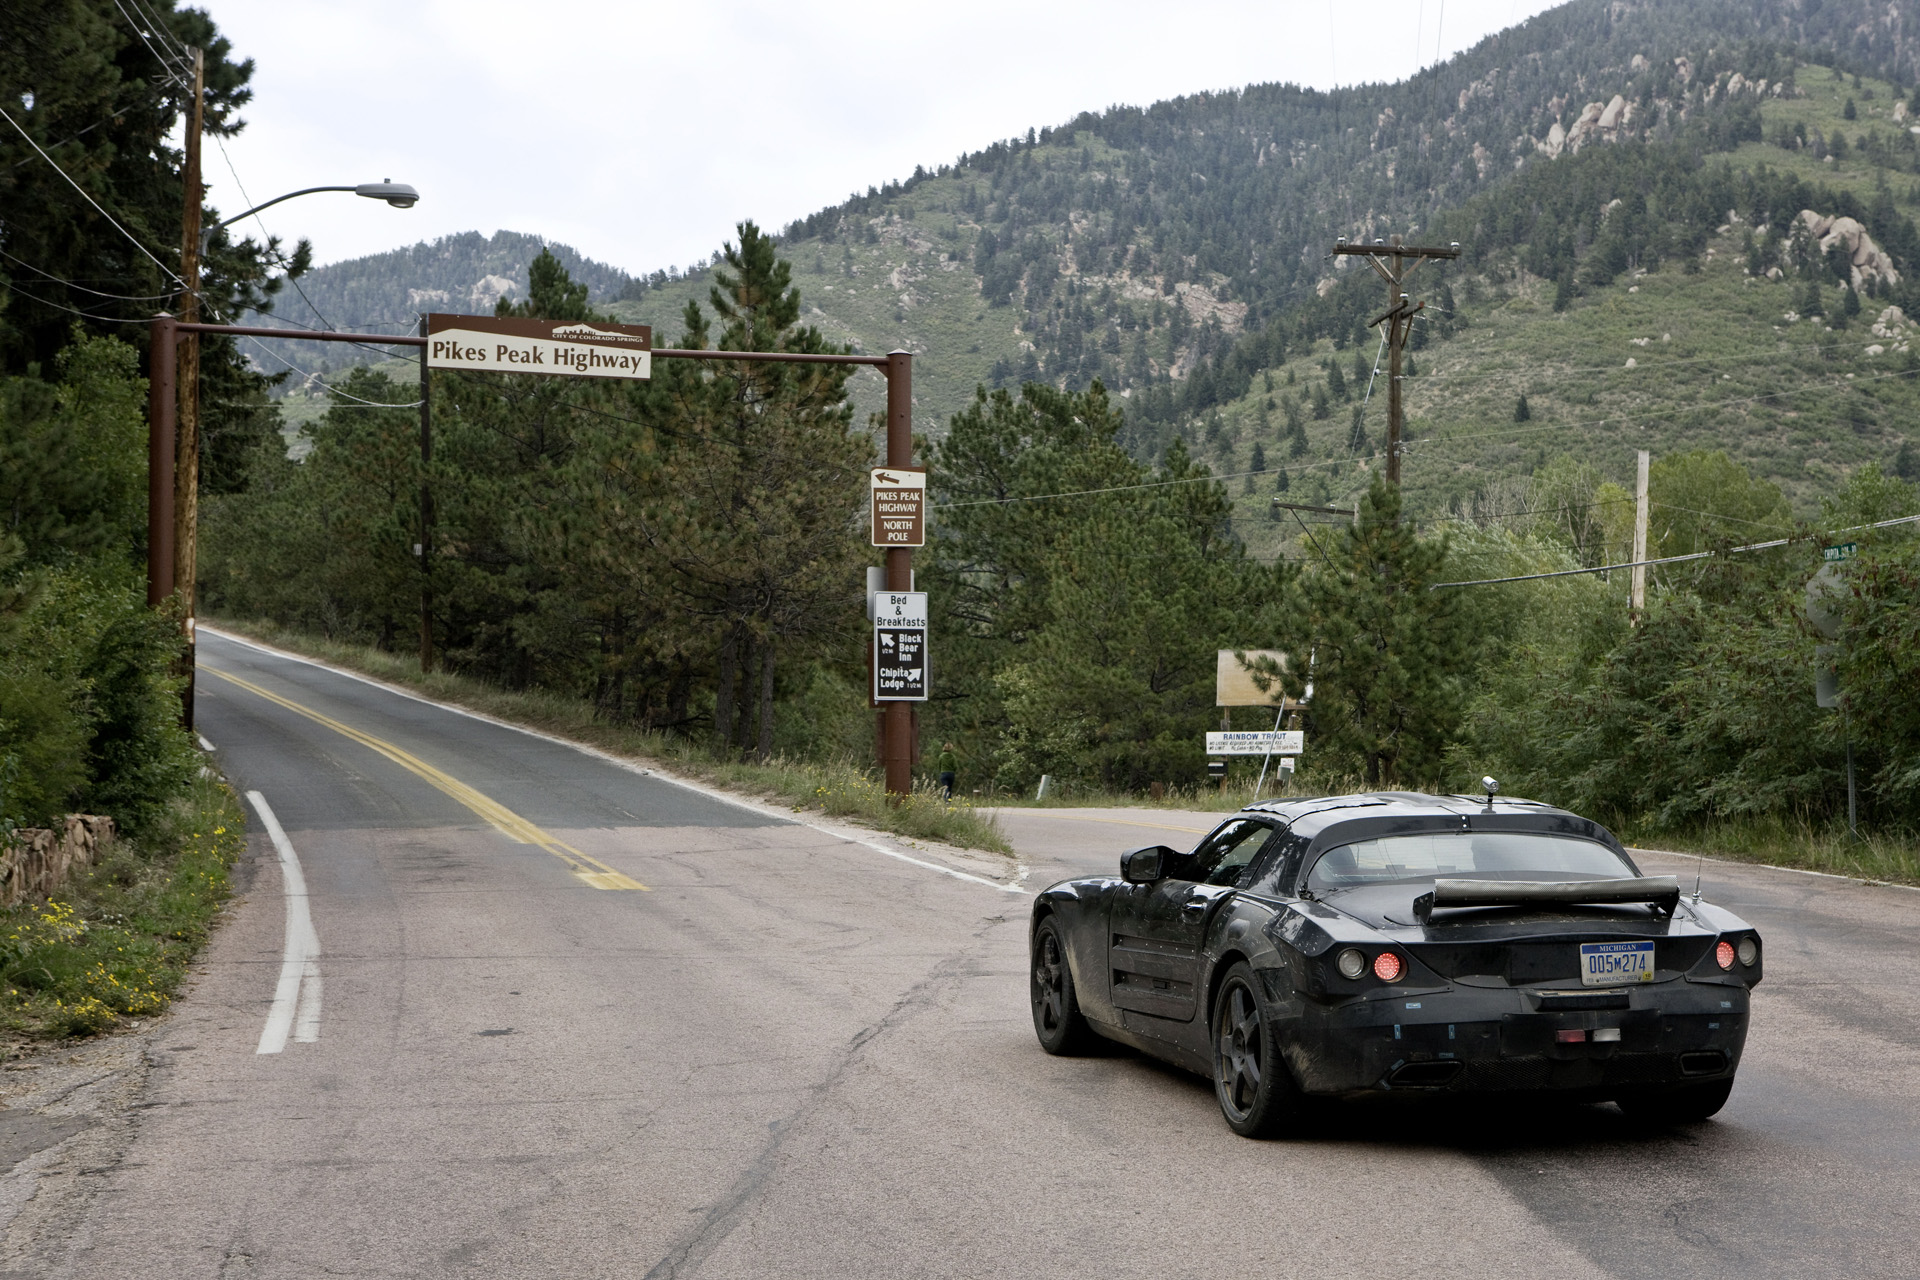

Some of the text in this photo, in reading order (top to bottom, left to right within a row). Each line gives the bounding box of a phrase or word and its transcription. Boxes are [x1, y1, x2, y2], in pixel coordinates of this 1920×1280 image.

[578, 334, 616, 342] COLORADO
[433, 340, 642, 374] Pikes Peak Highway
[876, 491, 920, 501] PIKES PEAK
[878, 503, 917, 512] HIGHWAY
[883, 521, 912, 530] NORTH
[888, 532, 908, 541] POLE
[890, 595, 907, 605] Bed
[895, 605, 902, 616] &
[877, 616, 926, 627] Breakfasts
[899, 633, 922, 643] Black
[899, 643, 919, 652] Bear
[899, 653, 912, 662] Inn
[880, 667, 909, 679] Chipita
[880, 679, 905, 690] Lodge
[1262, 732, 1287, 740] TROUT
[1589, 953, 1645, 973] 005M274
